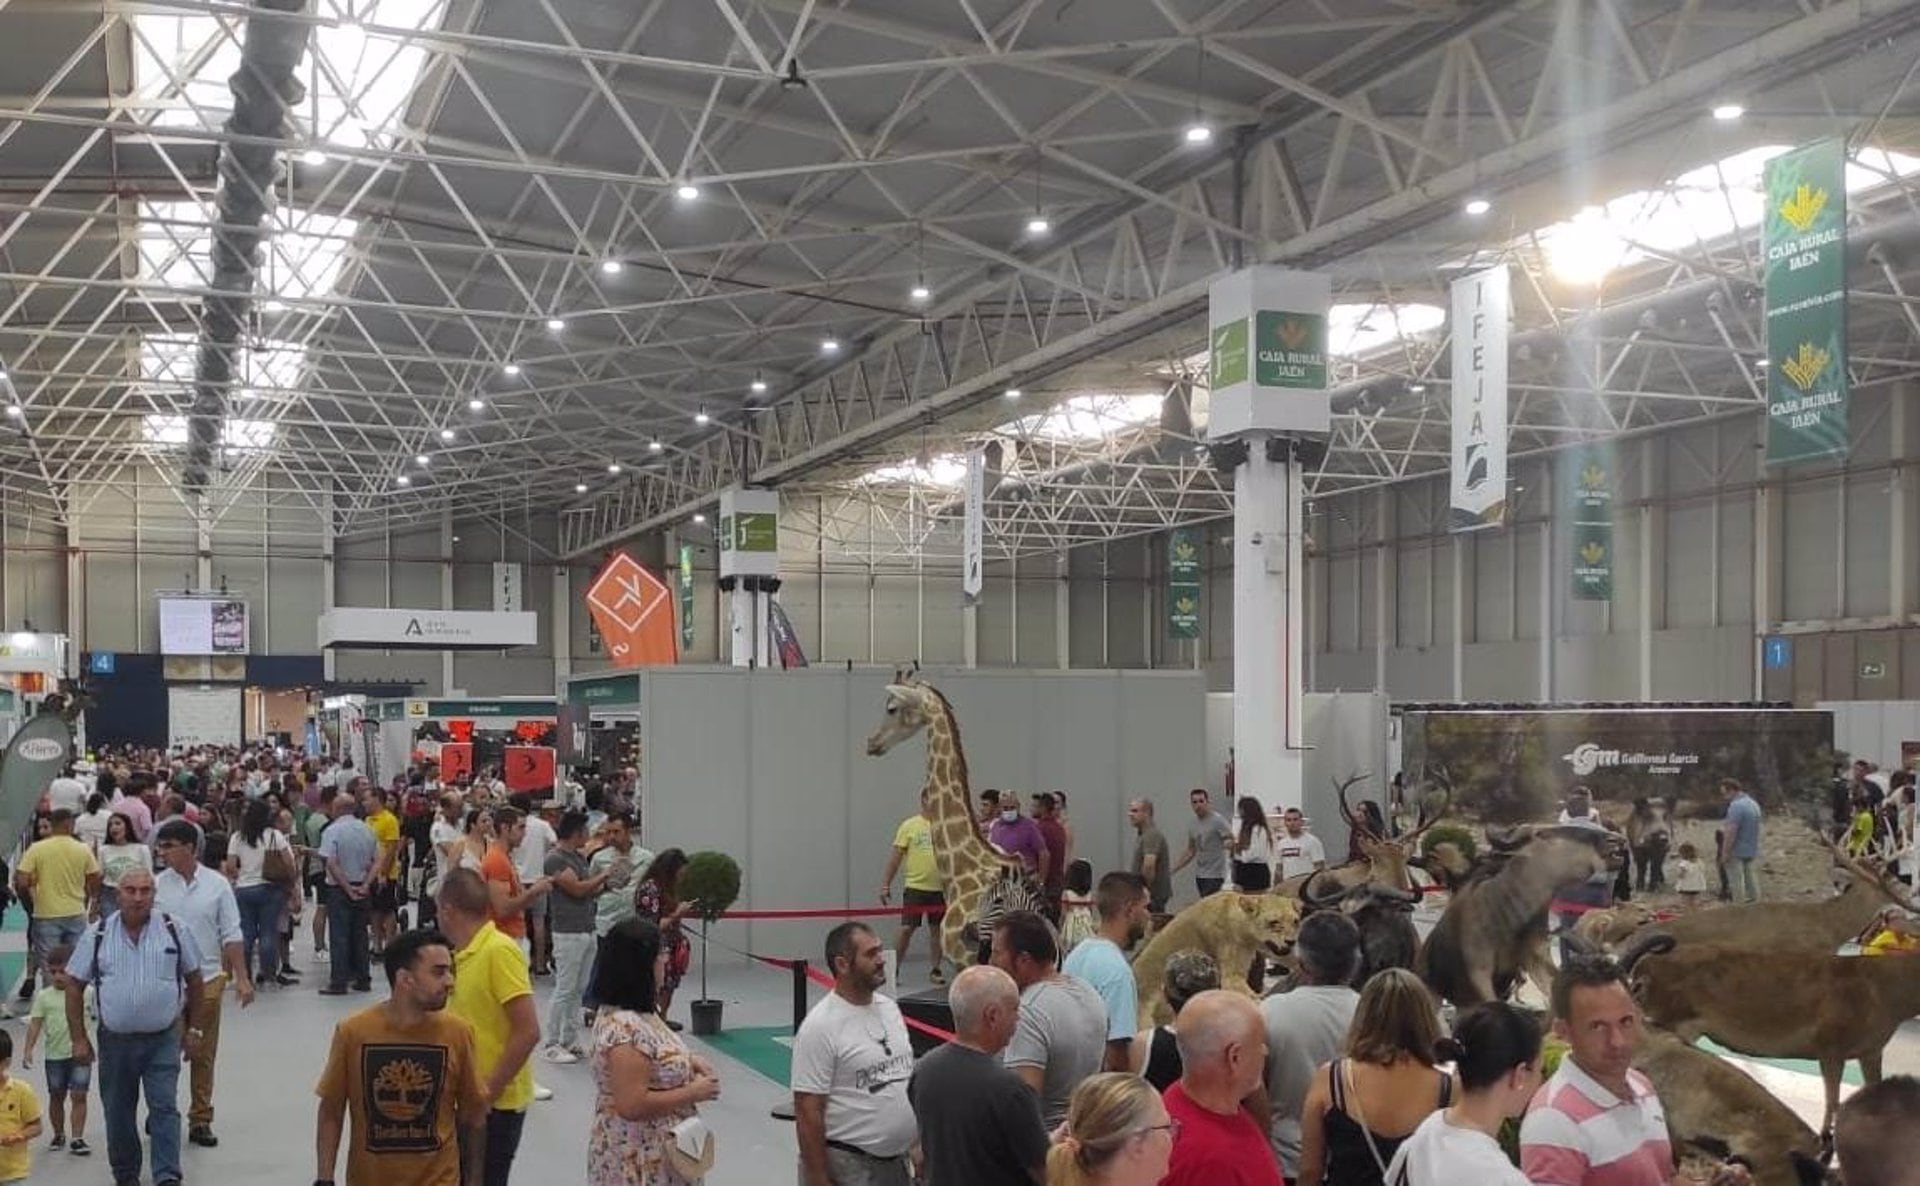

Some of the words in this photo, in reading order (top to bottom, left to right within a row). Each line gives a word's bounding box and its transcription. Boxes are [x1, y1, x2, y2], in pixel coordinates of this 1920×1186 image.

[1768, 241, 1798, 259] CAJA
[1799, 228, 1841, 251] RURAL
[1259, 351, 1285, 362] CAJA
[1288, 352, 1325, 366] RURAL
[1470, 281, 1484, 436] IFEJA
[1770, 401, 1799, 415] CAJA
[1801, 391, 1842, 410] RURAL
[97, 655, 108, 670] 4
